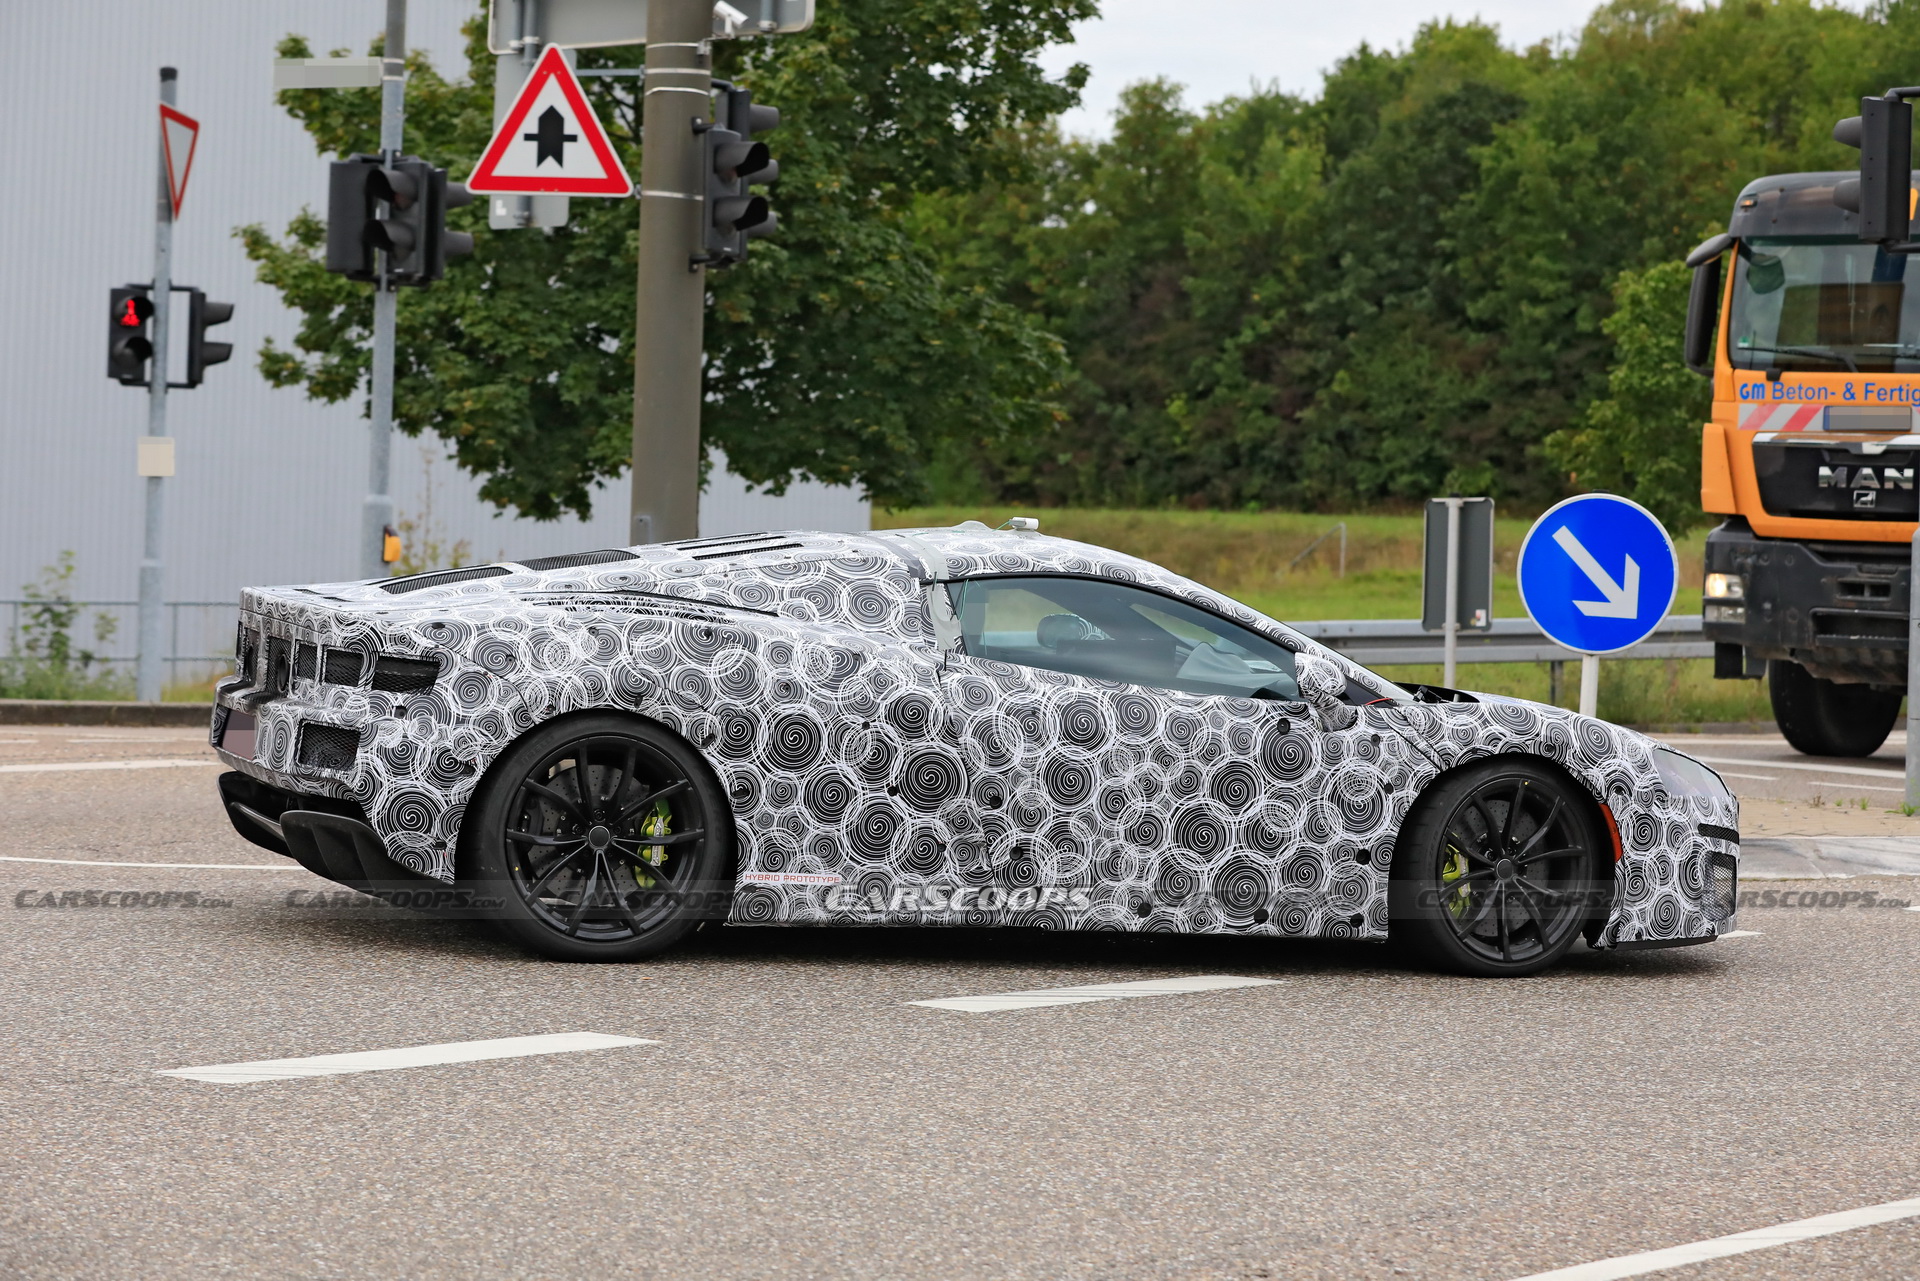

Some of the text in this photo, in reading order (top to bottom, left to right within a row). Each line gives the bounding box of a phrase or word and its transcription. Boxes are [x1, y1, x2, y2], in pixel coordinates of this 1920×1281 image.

[1739, 382, 1920, 407] GM Beton- & Fertig
[1819, 466, 1914, 489] MAN
[745, 873, 840, 884] HYBRID PROTOTYPE
